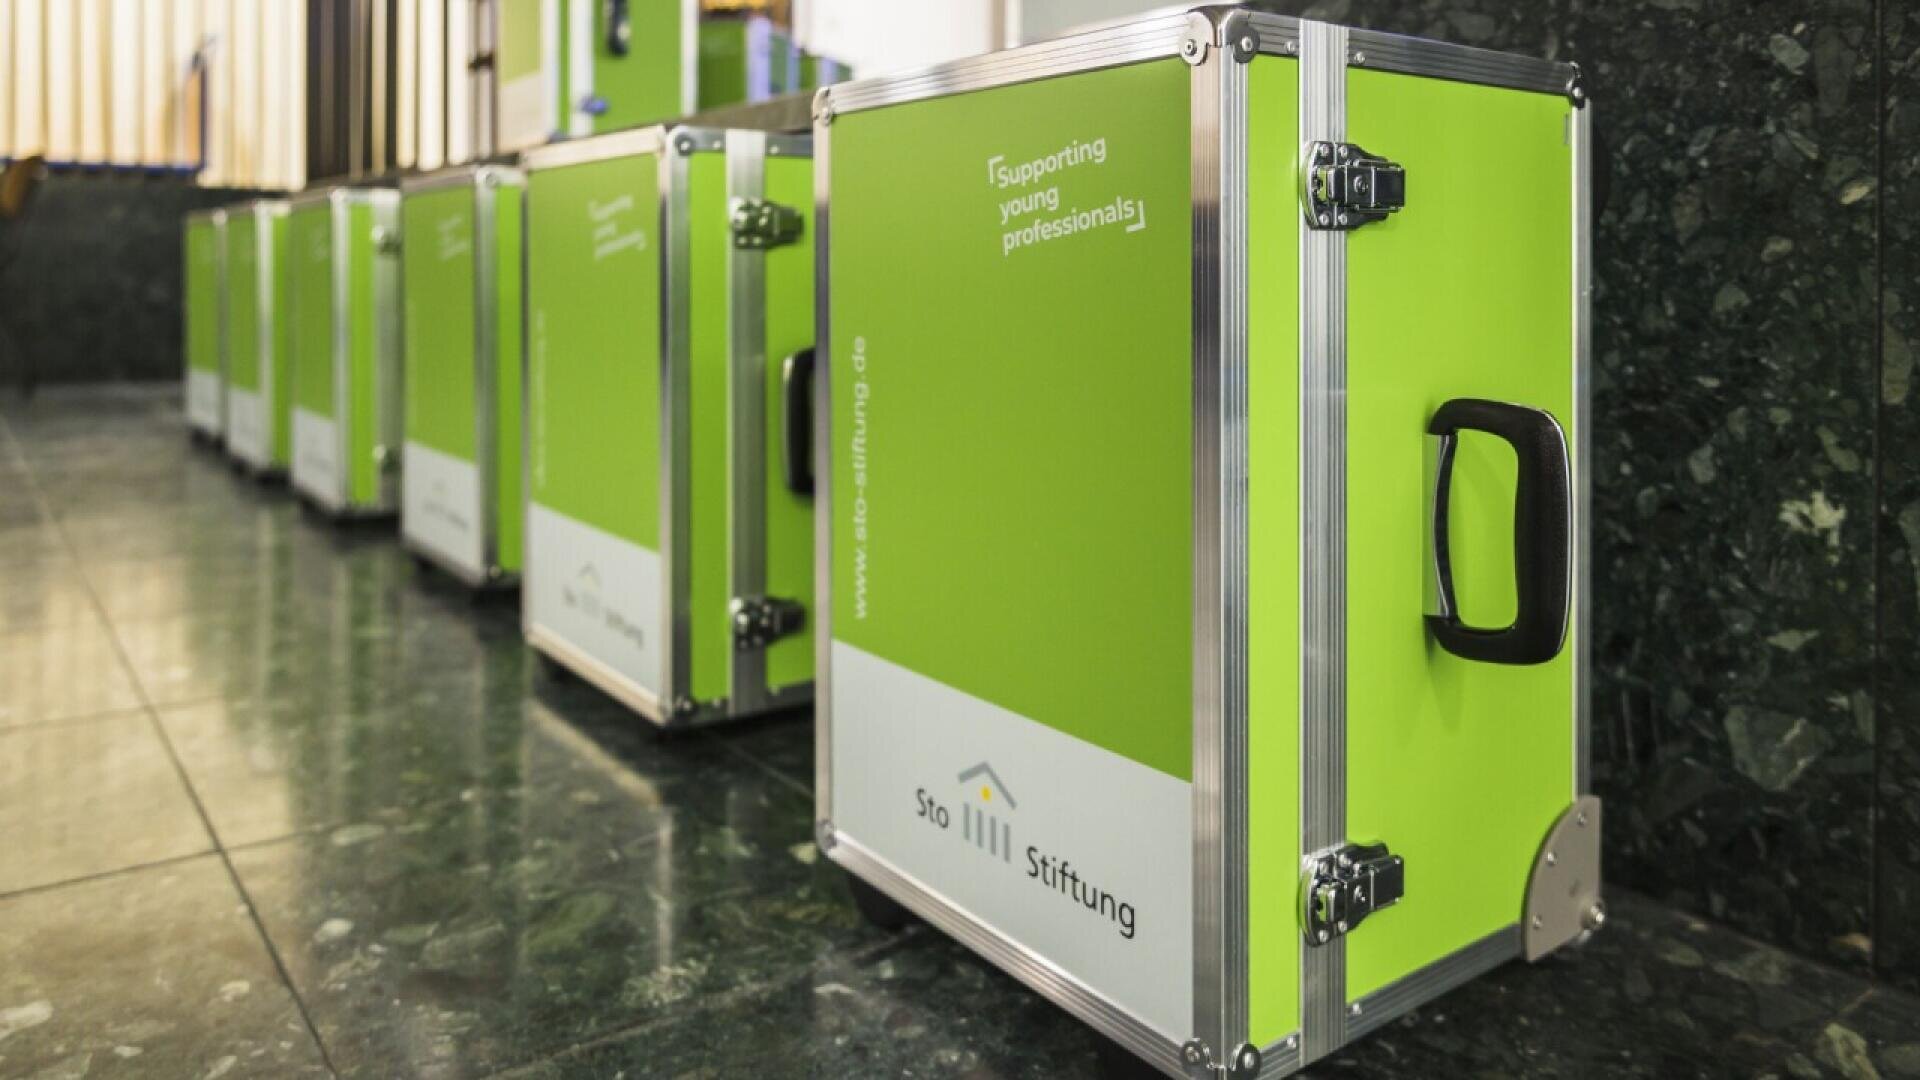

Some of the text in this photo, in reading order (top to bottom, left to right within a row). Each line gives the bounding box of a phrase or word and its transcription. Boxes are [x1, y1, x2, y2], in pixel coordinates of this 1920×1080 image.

[997, 137, 1106, 188] Supporting
[999, 187, 1058, 225] young
[1003, 196, 1135, 256] professionals
[851, 336, 869, 619] www.sto-stiftung.de
[916, 788, 949, 829] Sto
[1026, 846, 1135, 939] Stiftung
